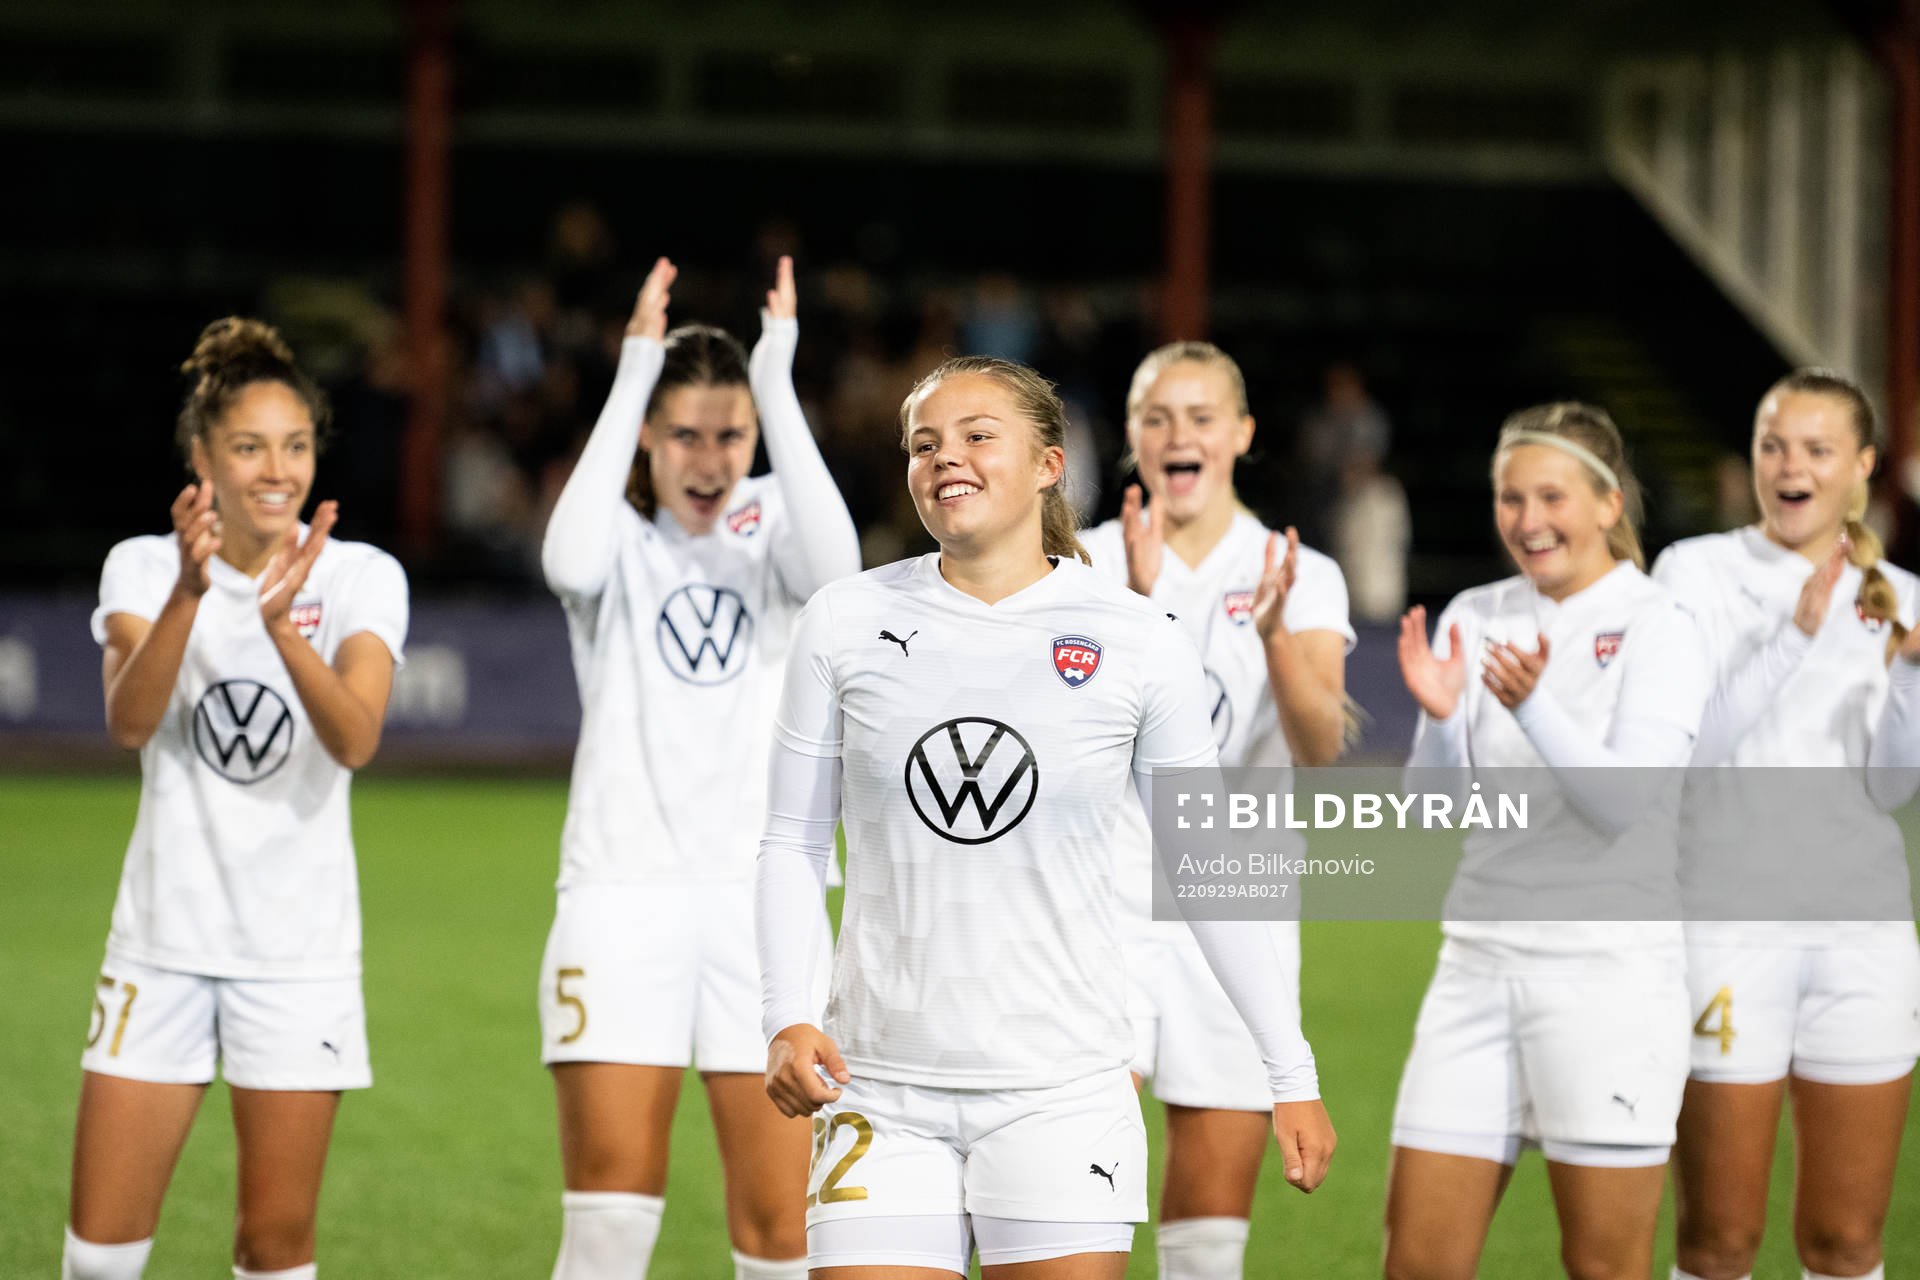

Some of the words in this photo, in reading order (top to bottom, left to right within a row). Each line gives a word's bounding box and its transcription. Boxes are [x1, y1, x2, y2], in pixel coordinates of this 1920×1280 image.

[1057, 648, 1096, 665] FCR
[556, 967, 587, 1044] 5
[1694, 984, 1736, 1056] 4
